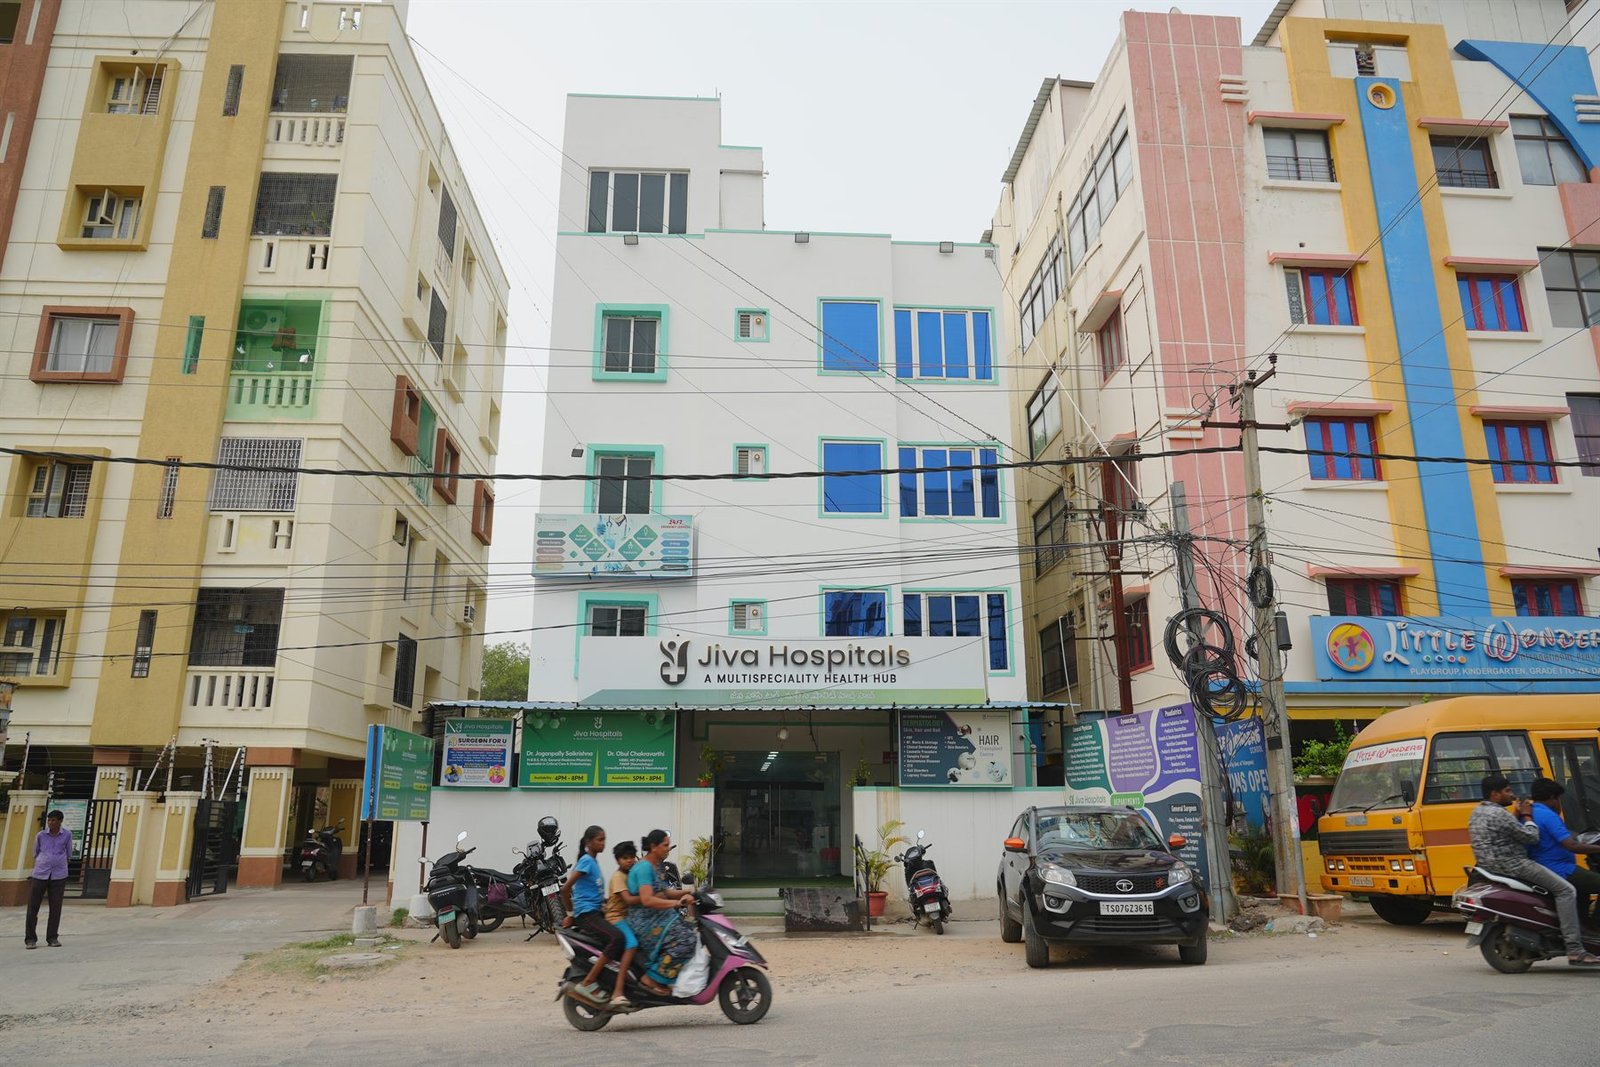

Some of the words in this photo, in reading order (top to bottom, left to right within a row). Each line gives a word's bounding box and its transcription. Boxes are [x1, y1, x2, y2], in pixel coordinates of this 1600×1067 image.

[698, 644, 759, 667] Jiva
[770, 644, 912, 674] Hospitals
[1410, 667, 1461, 676] PLAYGROUP,
[704, 674, 712, 684] A
[717, 673, 820, 684] MULTISPECIALITY
[824, 673, 868, 684] HEALTH
[873, 673, 898, 684] HUB
[589, 730, 623, 738] Hospitals
[979, 735, 1000, 746] HAIR
[1106, 904, 1152, 913] TS07GZ3616
